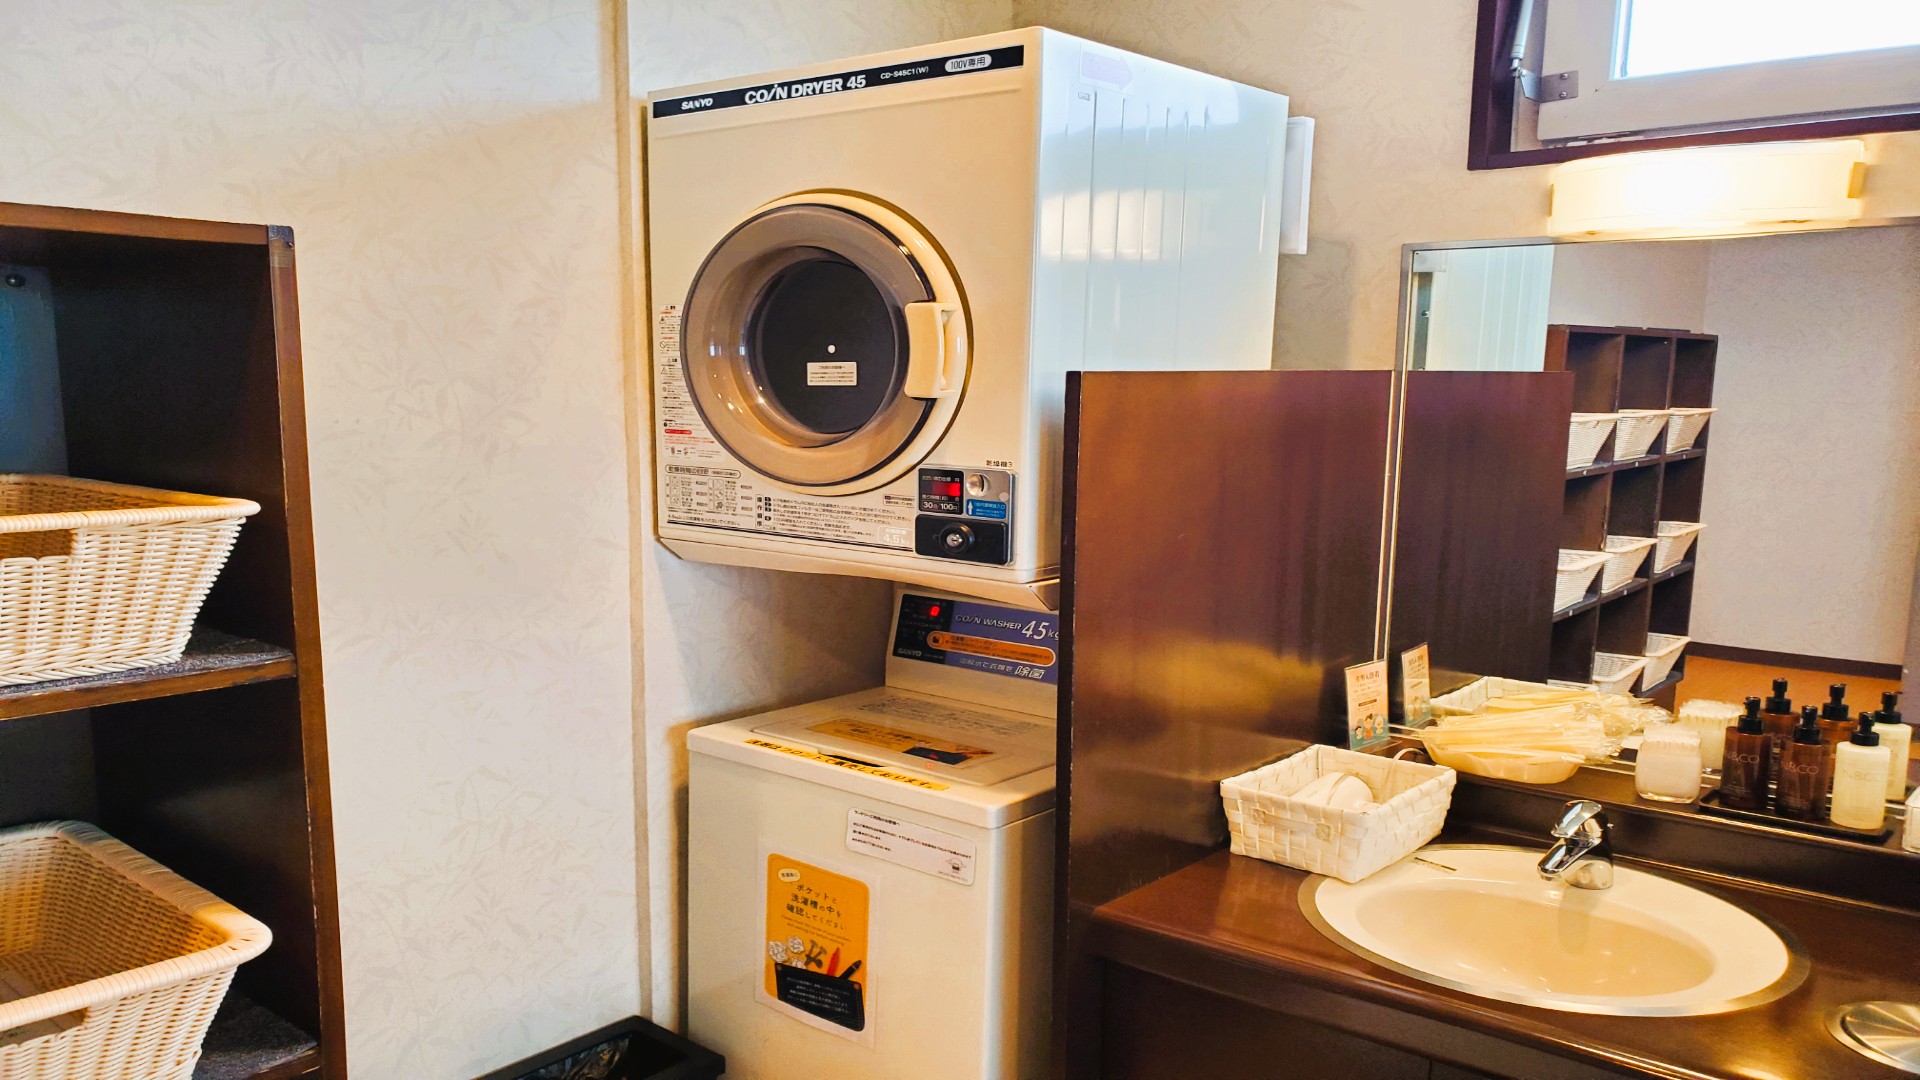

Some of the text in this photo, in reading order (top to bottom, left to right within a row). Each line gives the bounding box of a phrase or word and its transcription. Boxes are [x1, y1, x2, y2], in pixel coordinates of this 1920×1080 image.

[681, 97, 713, 111] SANYO
[790, 79, 844, 98] DRYER
[846, 74, 867, 89] 45
[983, 618, 1022, 630] WASHER
[786, 903, 847, 930] 確認してください
